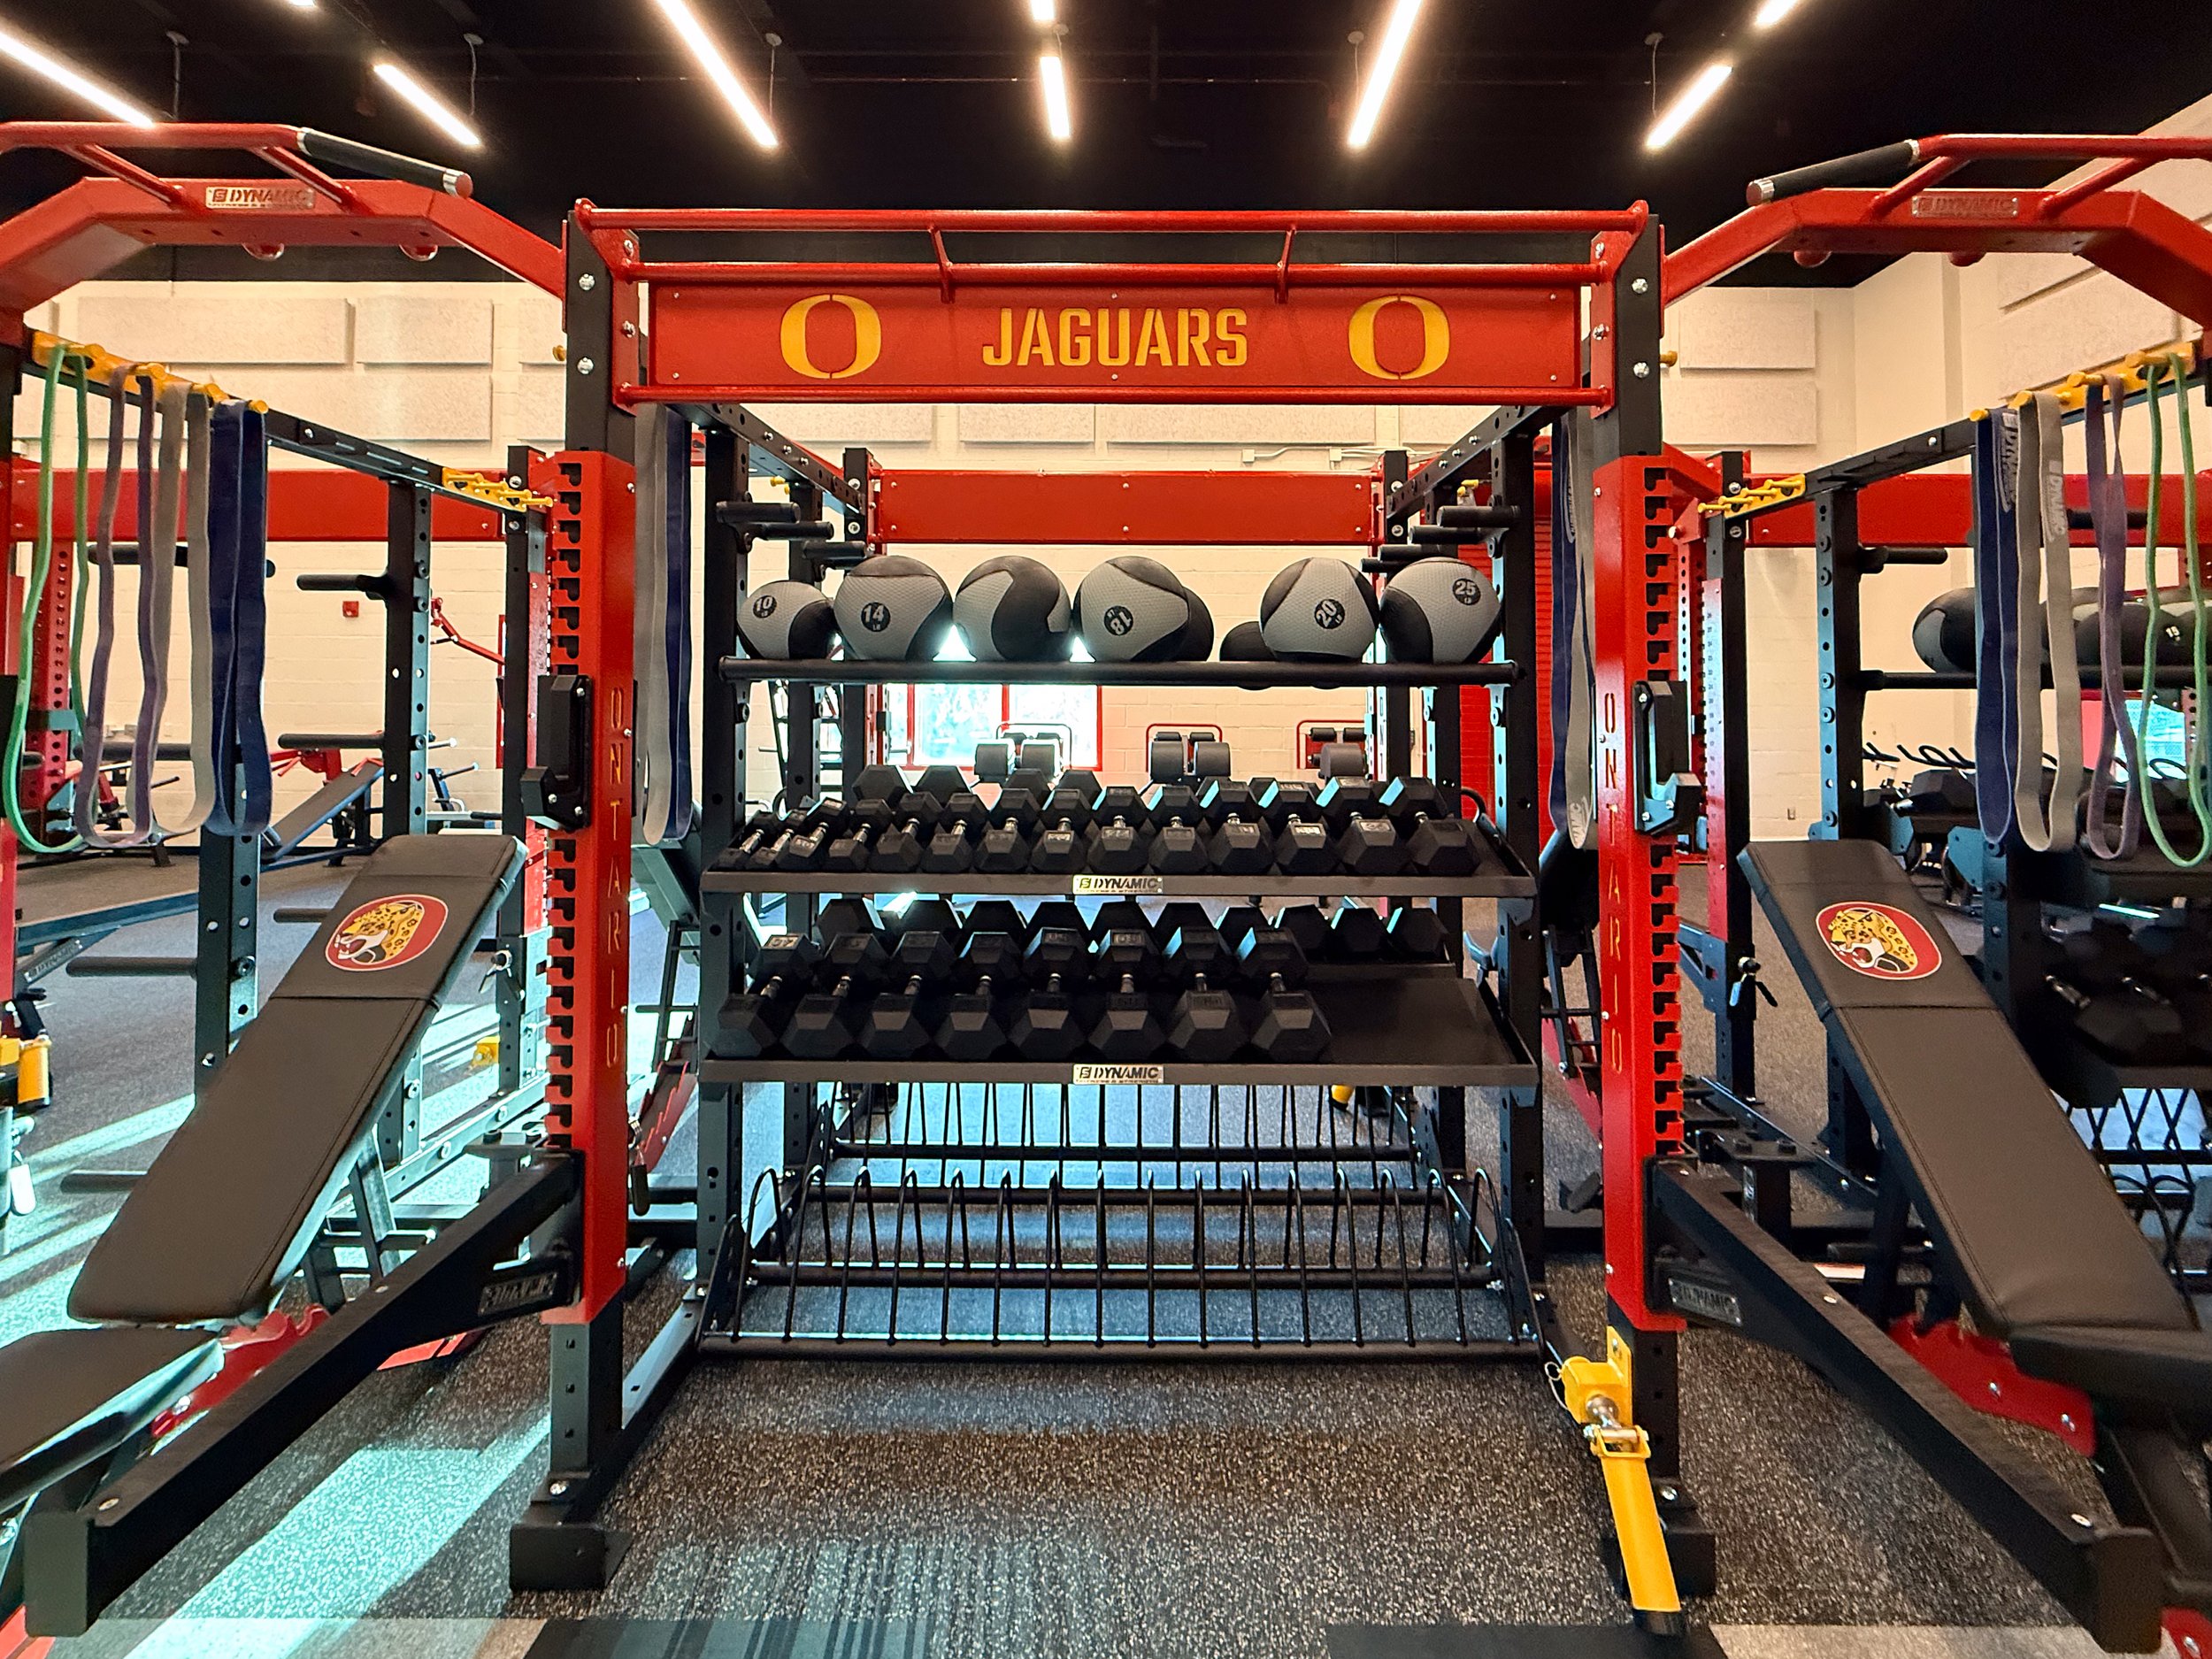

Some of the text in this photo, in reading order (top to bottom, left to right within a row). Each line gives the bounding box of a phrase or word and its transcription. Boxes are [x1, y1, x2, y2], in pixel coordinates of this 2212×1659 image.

[780, 294, 1450, 380] O JAGUARS O
[1455, 580, 1476, 595] 25
[756, 596, 773, 611] 10
[864, 605, 884, 623] 14
[1110, 611, 1132, 634] 18
[1316, 601, 1336, 627] 20
[607, 687, 624, 1068] ONTARIO
[1094, 878, 1157, 889] DYNAMIC
[1604, 692, 1623, 1074] ONTARIO
[1094, 1066, 1159, 1079] DYNAMIC
